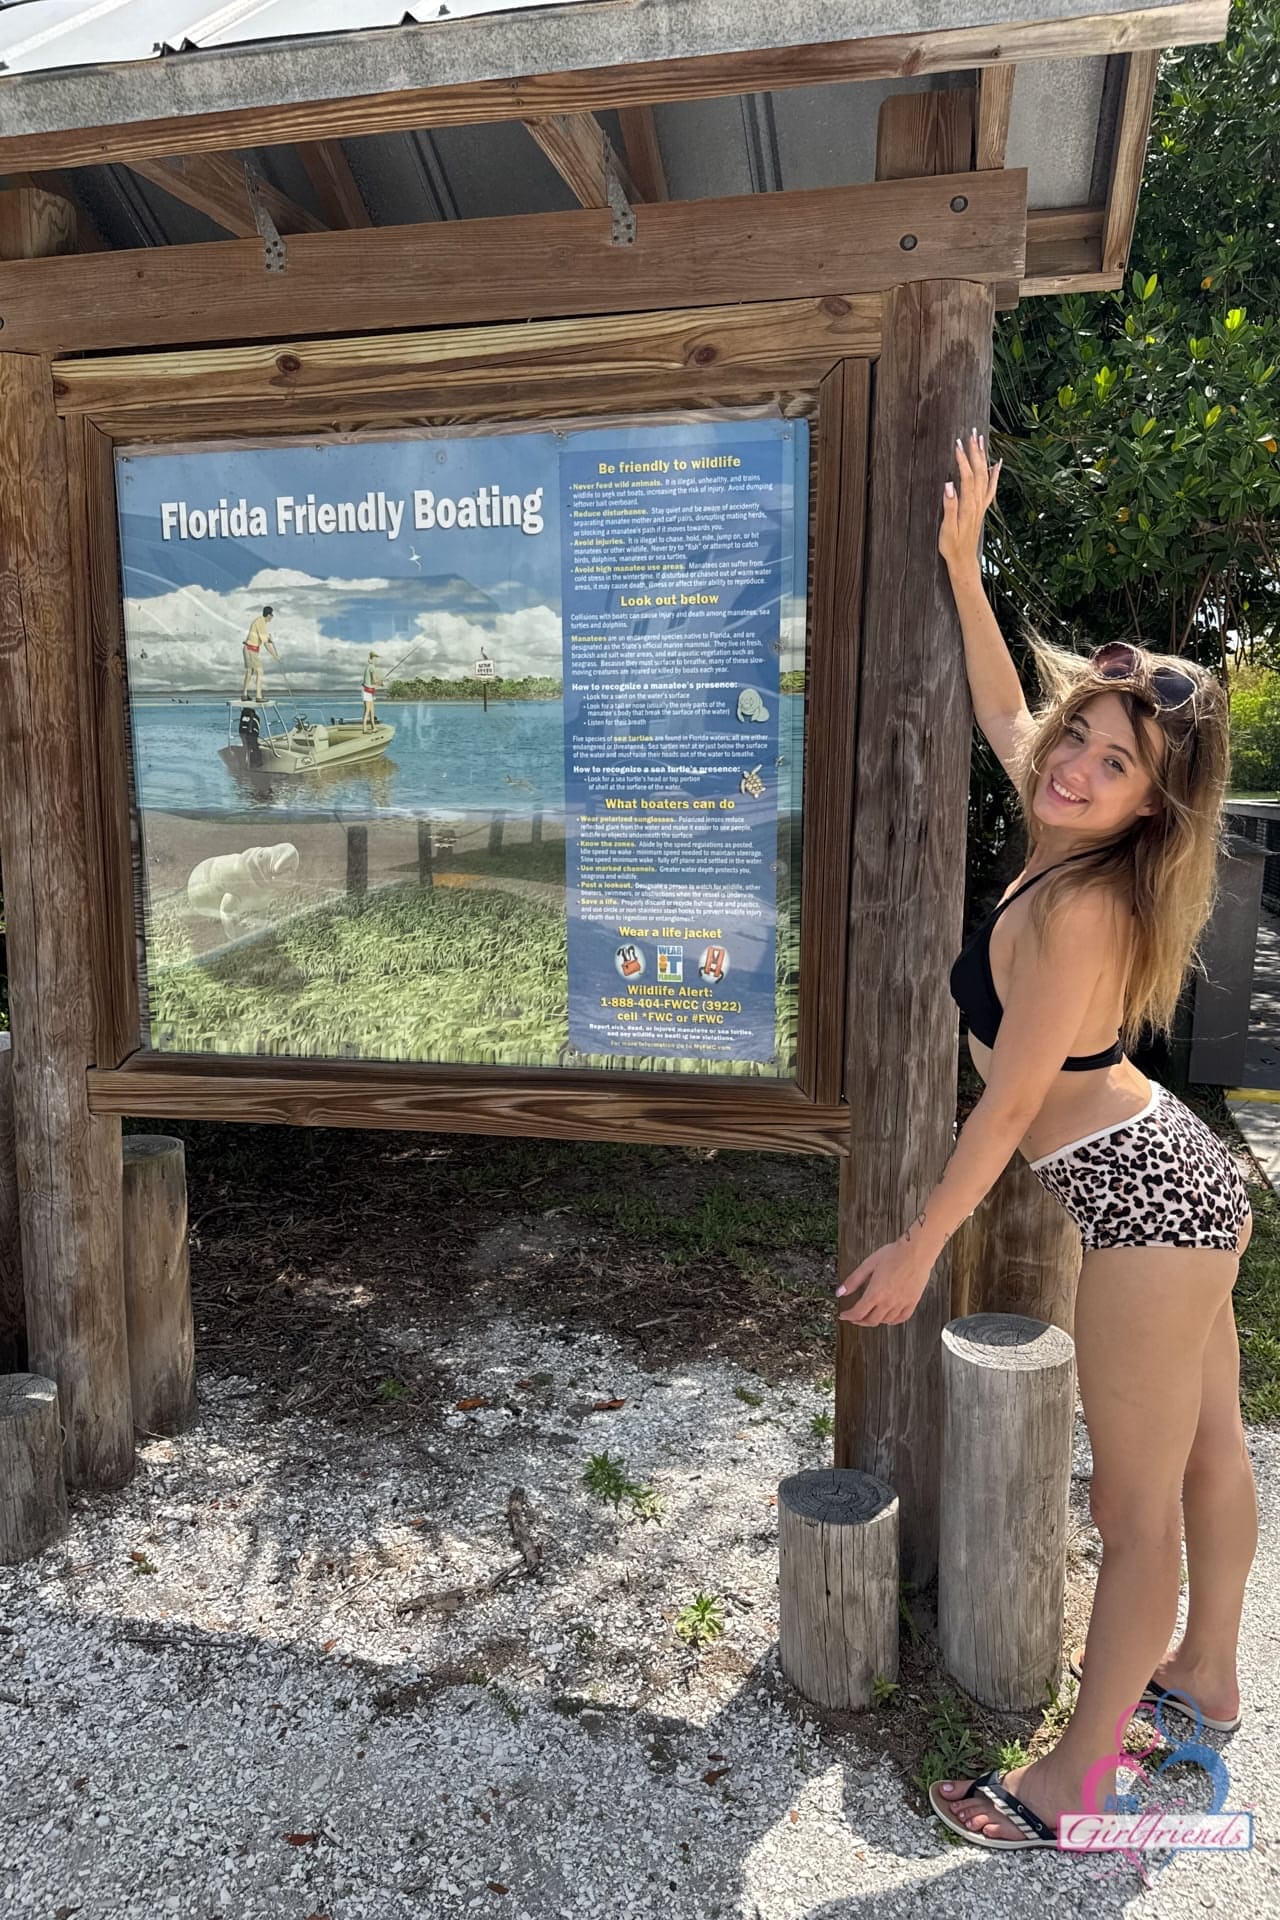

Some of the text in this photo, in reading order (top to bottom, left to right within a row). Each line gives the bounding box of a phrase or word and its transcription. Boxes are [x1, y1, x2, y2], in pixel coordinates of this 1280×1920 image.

[598, 456, 741, 474] Be friendly to wildlife
[161, 485, 544, 540] Florida Friendly Boating
[595, 565, 612, 574] high
[621, 593, 719, 607] Look out below
[601, 682, 641, 692] recognize
[650, 681, 694, 690] manatee's
[696, 682, 738, 690] presence:
[602, 765, 642, 775] recognize
[605, 798, 735, 809] What boaters can do
[599, 816, 633, 824] polarized
[619, 926, 722, 940] Wear a life jacket
[627, 985, 713, 997] Wildlife Alert:
[600, 997, 742, 1014] 1-888-404-FWCC (3922)
[617, 1012, 638, 1021] cell
[692, 1014, 724, 1024] #FWC
